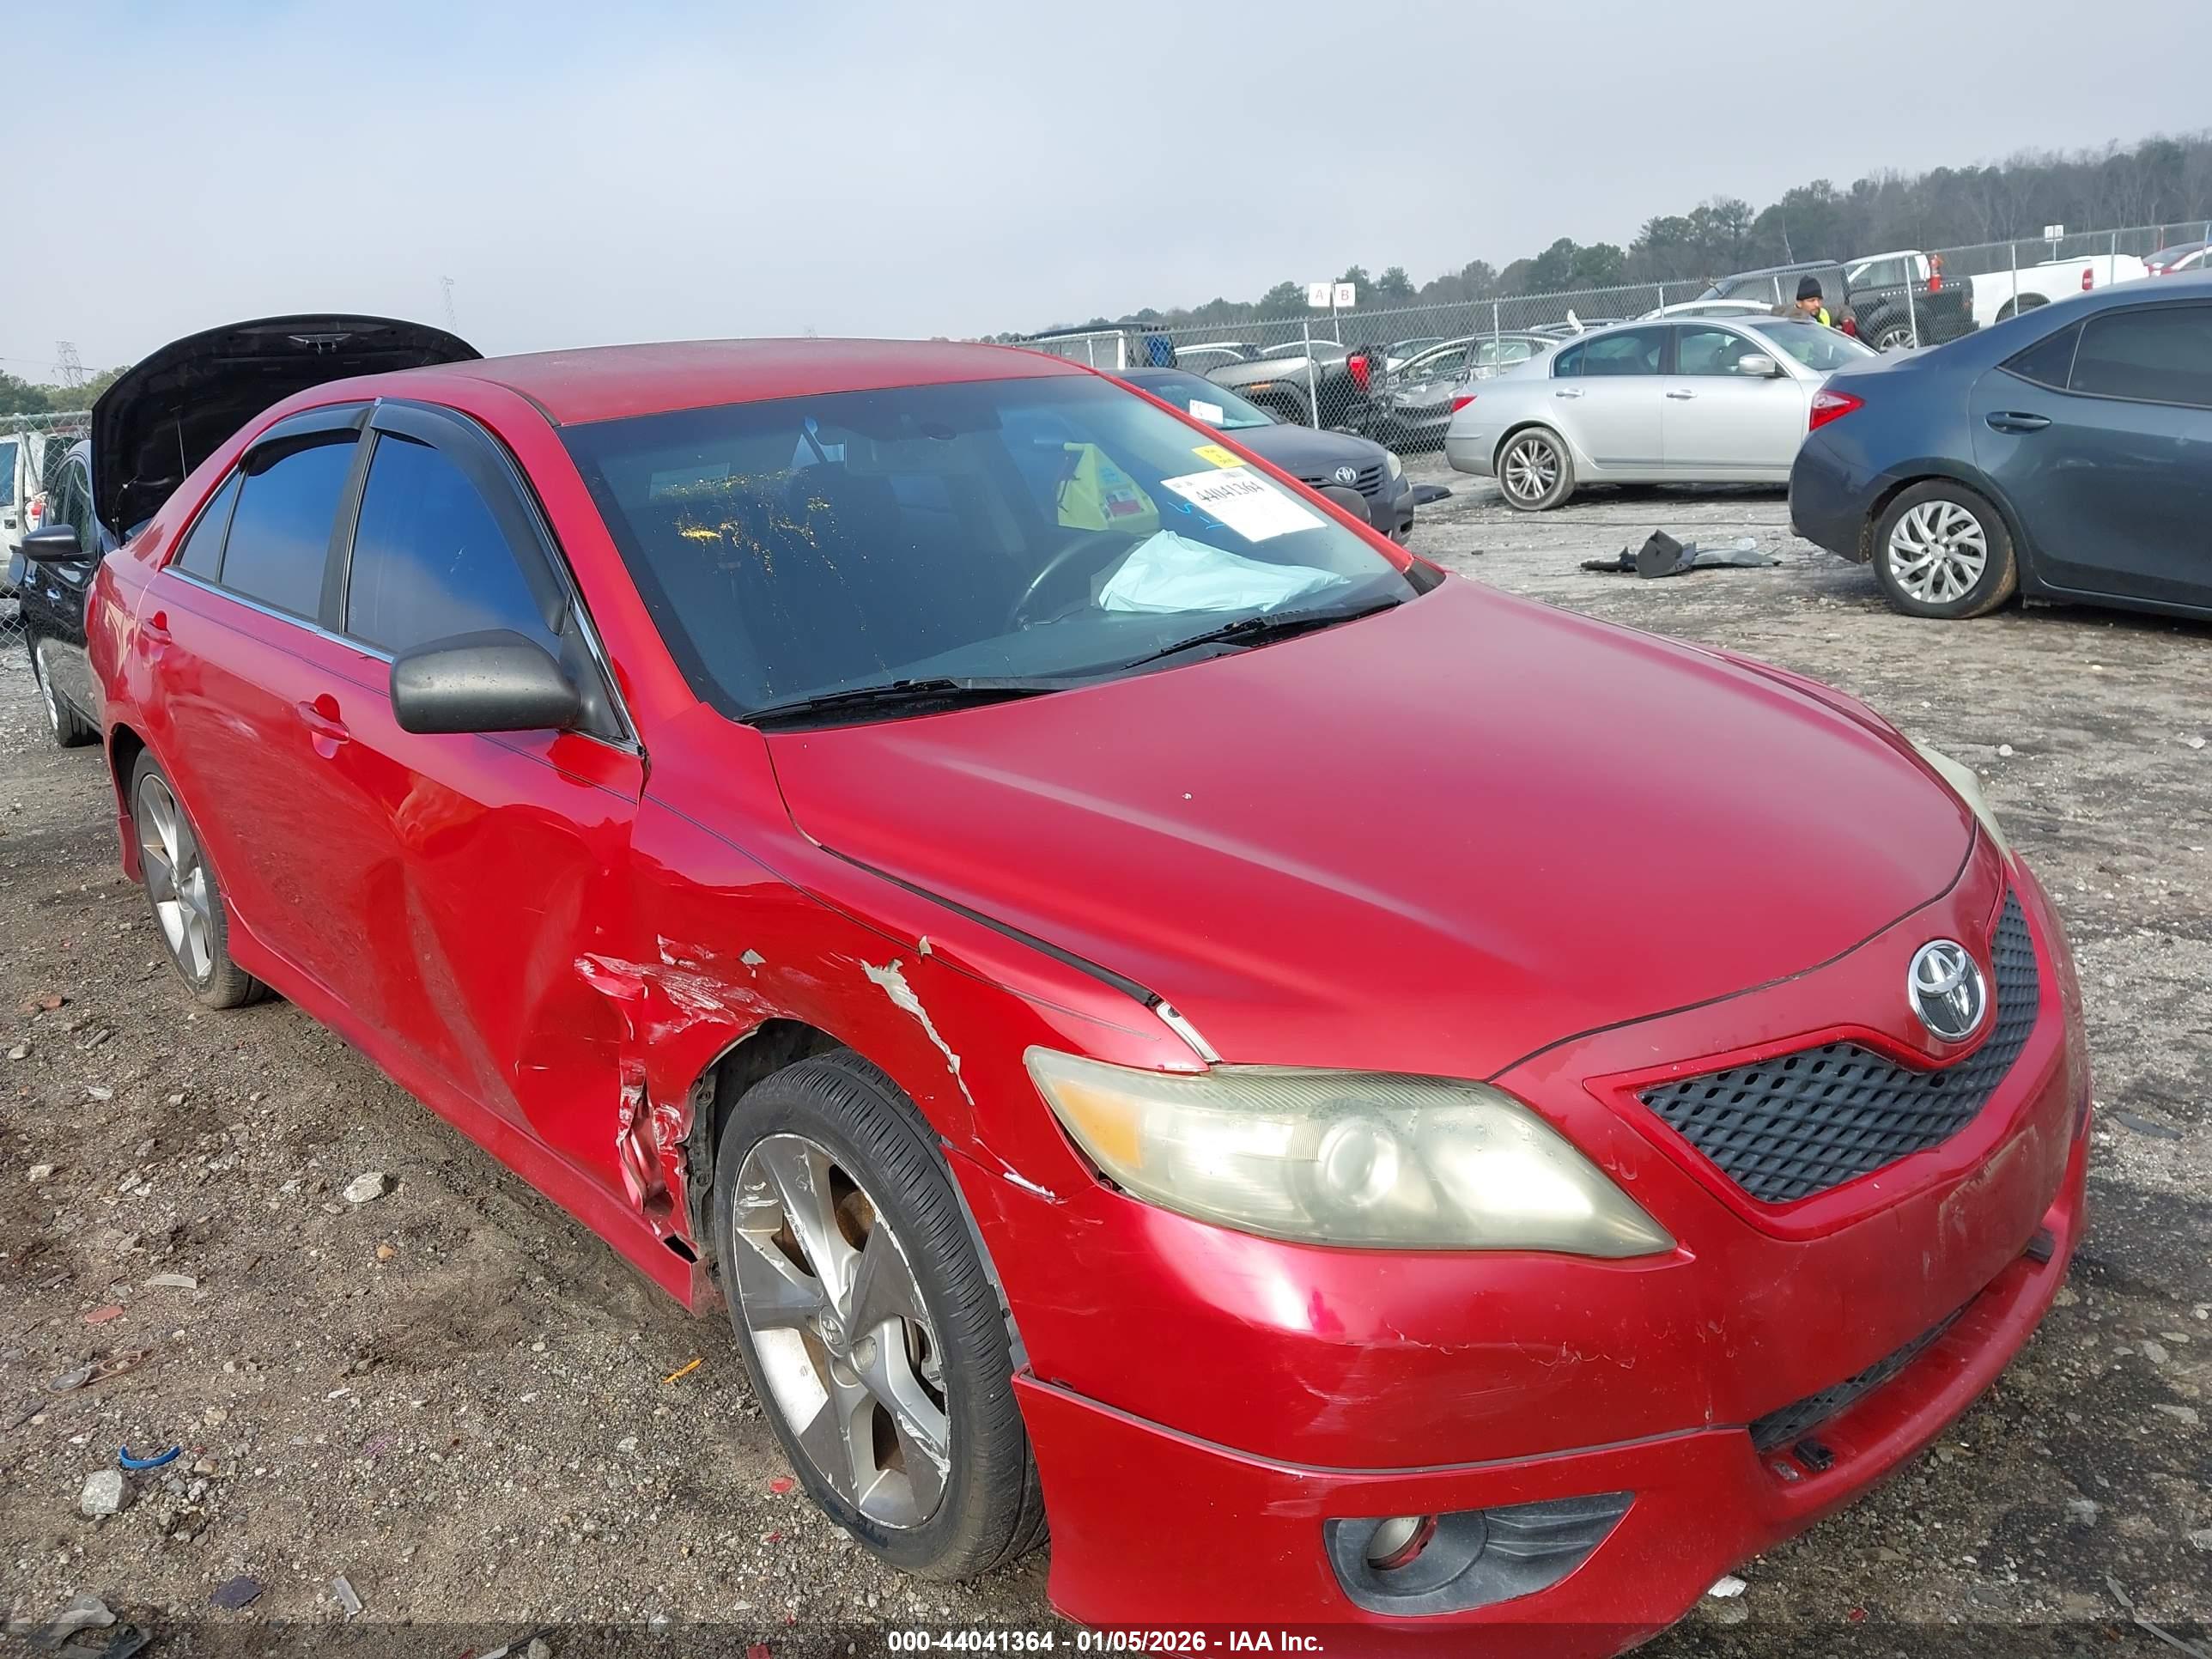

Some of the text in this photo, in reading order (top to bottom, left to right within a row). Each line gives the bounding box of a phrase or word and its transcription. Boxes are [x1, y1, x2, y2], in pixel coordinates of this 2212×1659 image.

[1315, 289, 1324, 301] A
[1340, 289, 1349, 301] B
[1195, 481, 1265, 502] 44041364
